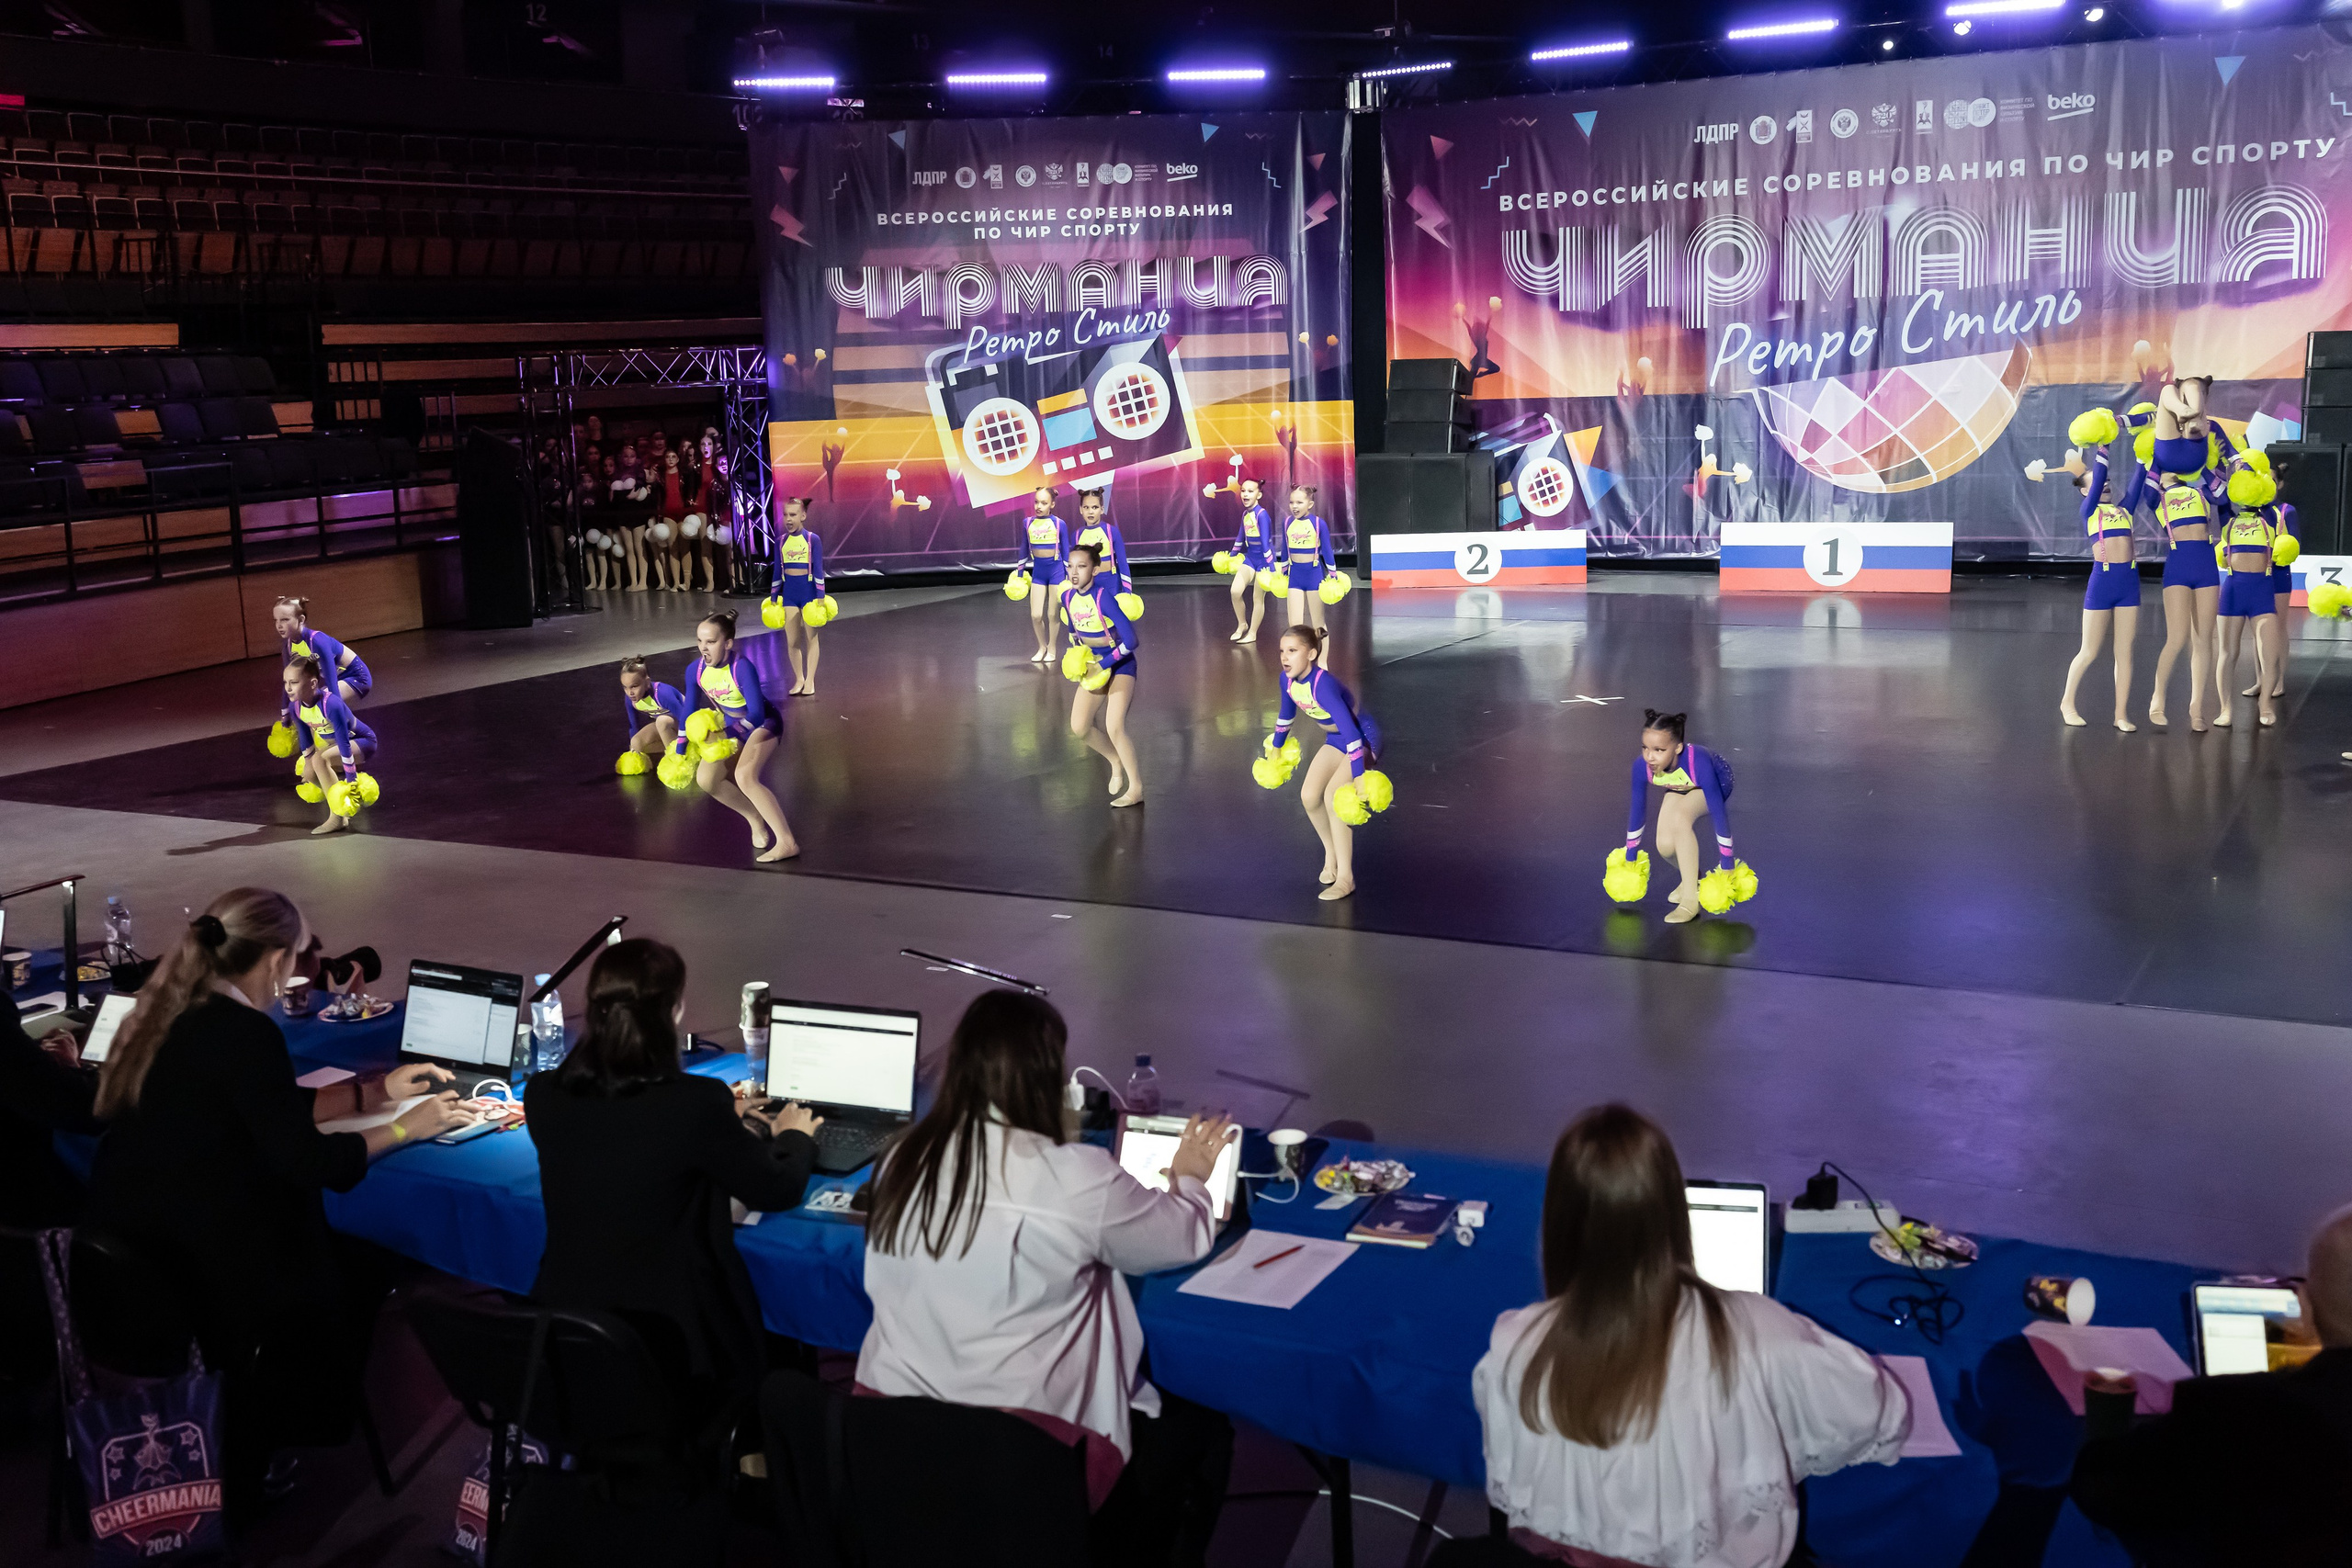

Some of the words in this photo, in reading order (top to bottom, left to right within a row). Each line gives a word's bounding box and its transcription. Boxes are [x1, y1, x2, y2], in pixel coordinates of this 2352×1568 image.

[525, 3, 548, 21] 12
[2047, 92, 2096, 110] beko
[1693, 123, 1739, 145] ЛДПР
[912, 171, 948, 186] ЛДПР
[1166, 163, 1199, 175] beko
[1499, 177, 1748, 212] ВСЕРОССИЙСКИЕ
[1762, 157, 2026, 194] СОРЕВНОВАНИЯ
[2043, 154, 2089, 175] ПО
[2106, 149, 2175, 171] ЧИР
[2191, 138, 2336, 166] СПОРТУ
[877, 207, 1057, 226] ВСЕРОССИЙСКИЕ
[1066, 203, 1234, 220] СОРЕВНОВАНИЯ
[974, 226, 1002, 241] ПО
[1011, 224, 1052, 239] ЧИР
[1061, 222, 1142, 237] СПОРТУ
[963, 325, 1061, 364] Ретро
[1073, 306, 1170, 345] Стиль
[1710, 321, 1877, 387] Ретро
[1901, 288, 2083, 354] Стиль
[1466, 543, 1489, 575] 2
[1822, 537, 1844, 576] 1
[2321, 566, 2343, 586] 3
[95, 1483, 222, 1533] CHEERMANIA
[145, 1534, 183, 1557] 2024
